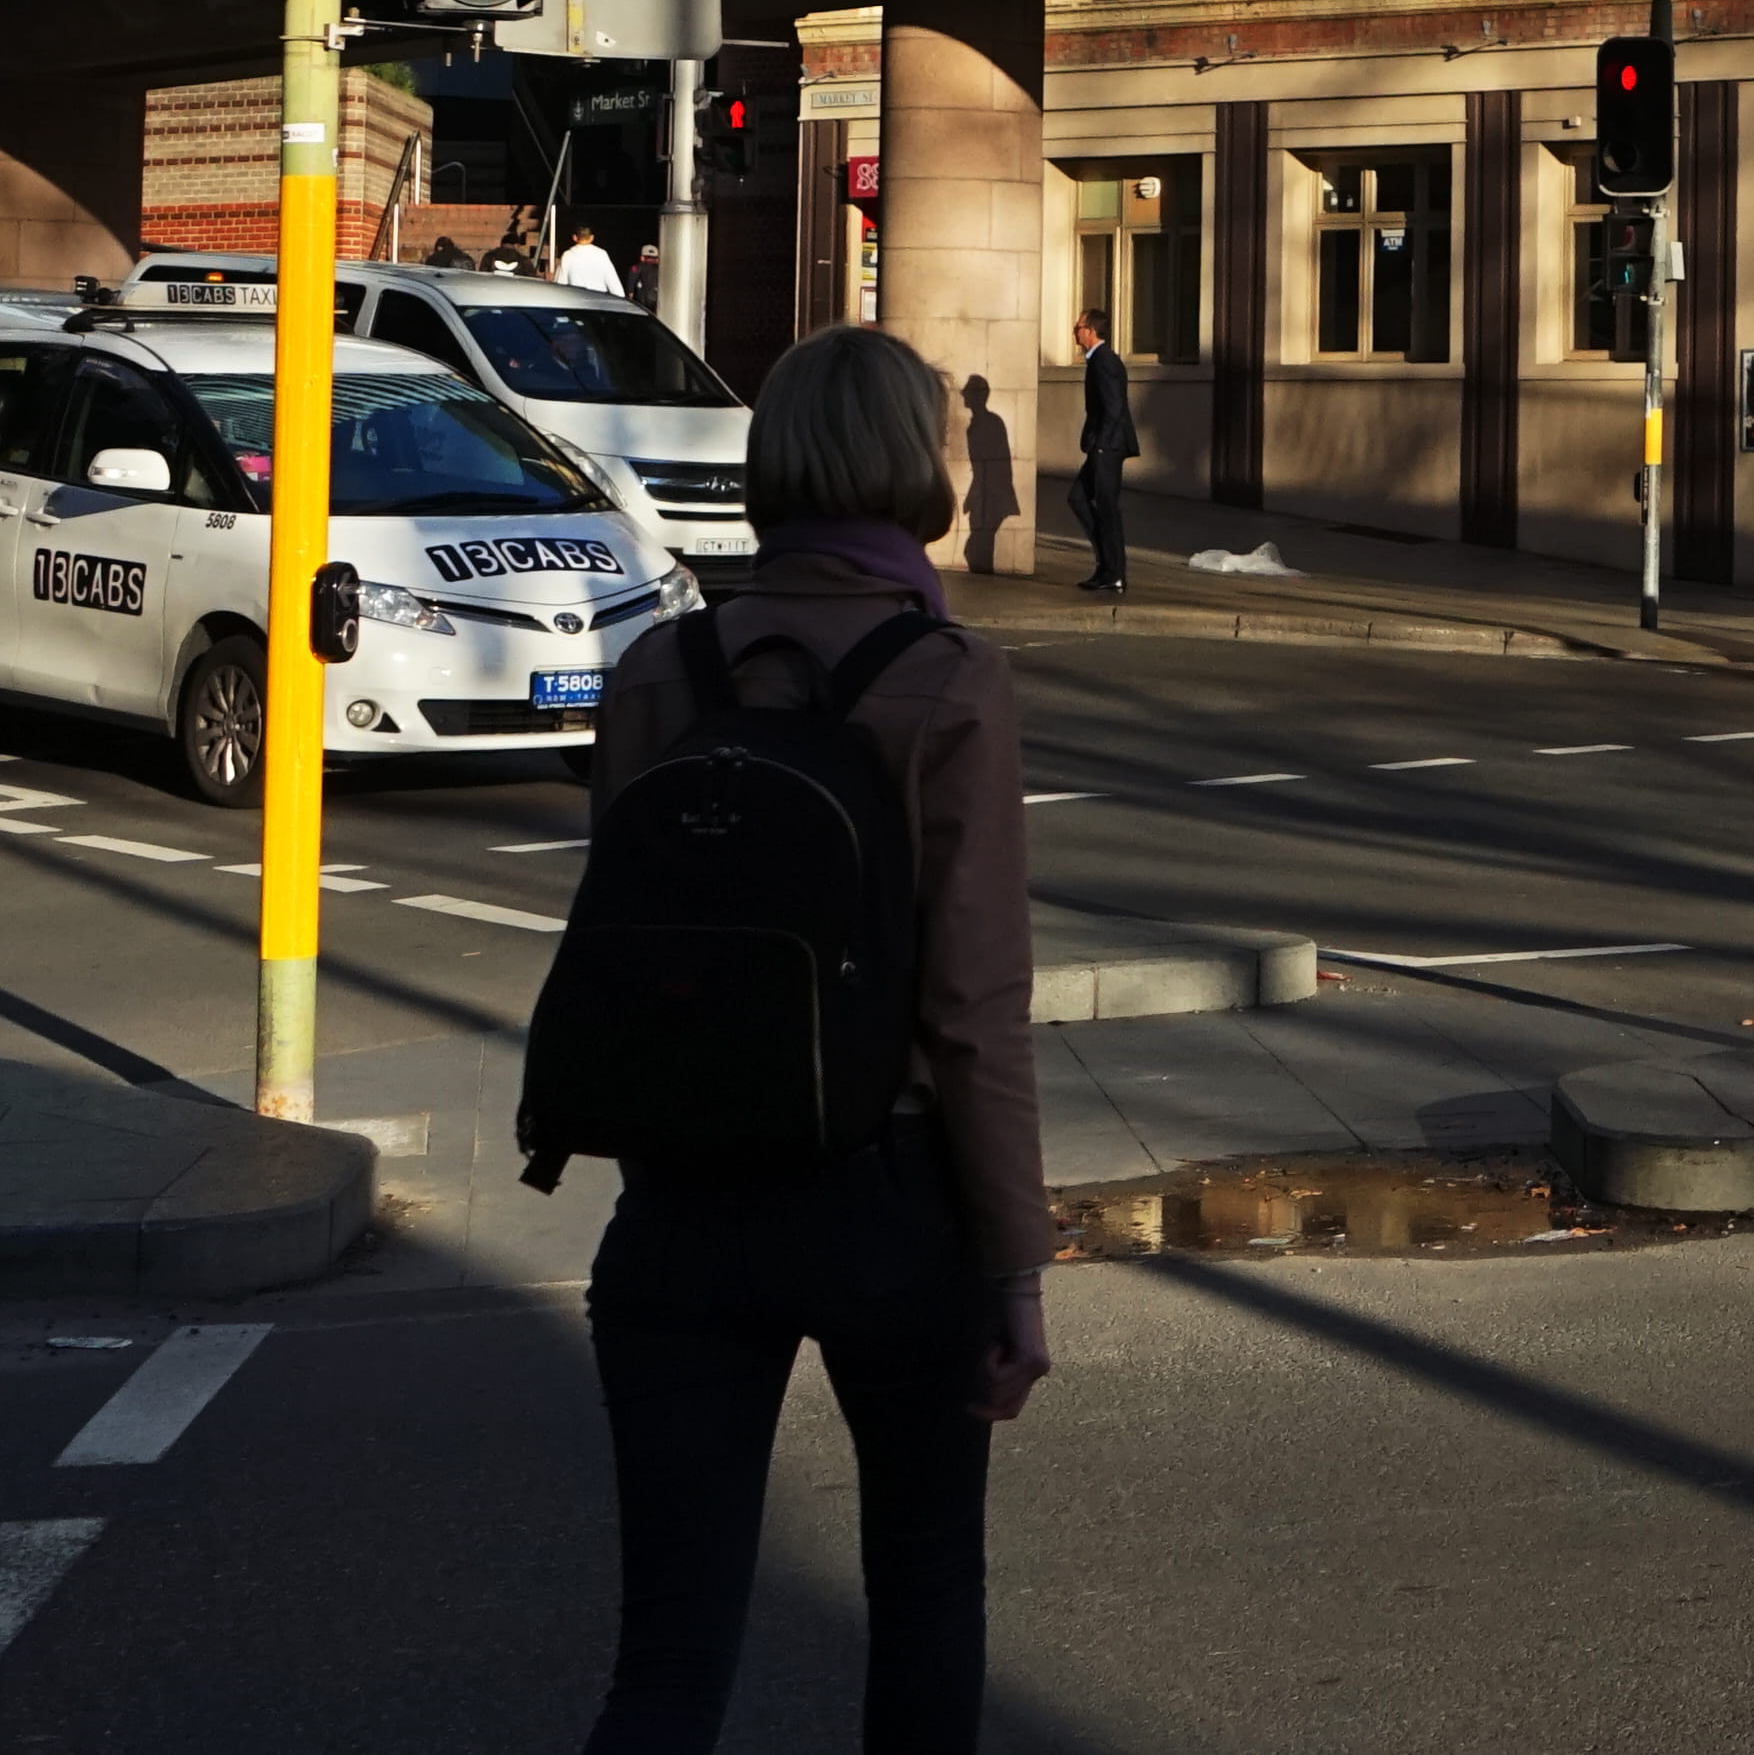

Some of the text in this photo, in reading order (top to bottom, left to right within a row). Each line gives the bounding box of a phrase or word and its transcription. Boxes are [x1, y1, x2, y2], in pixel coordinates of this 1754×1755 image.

[591, 91, 636, 112] Market
[1383, 237, 1403, 247] ATM
[167, 284, 236, 305] 13CABS
[205, 512, 237, 530] 5808
[428, 539, 620, 580] 13CABS
[36, 549, 146, 613] 13CABS
